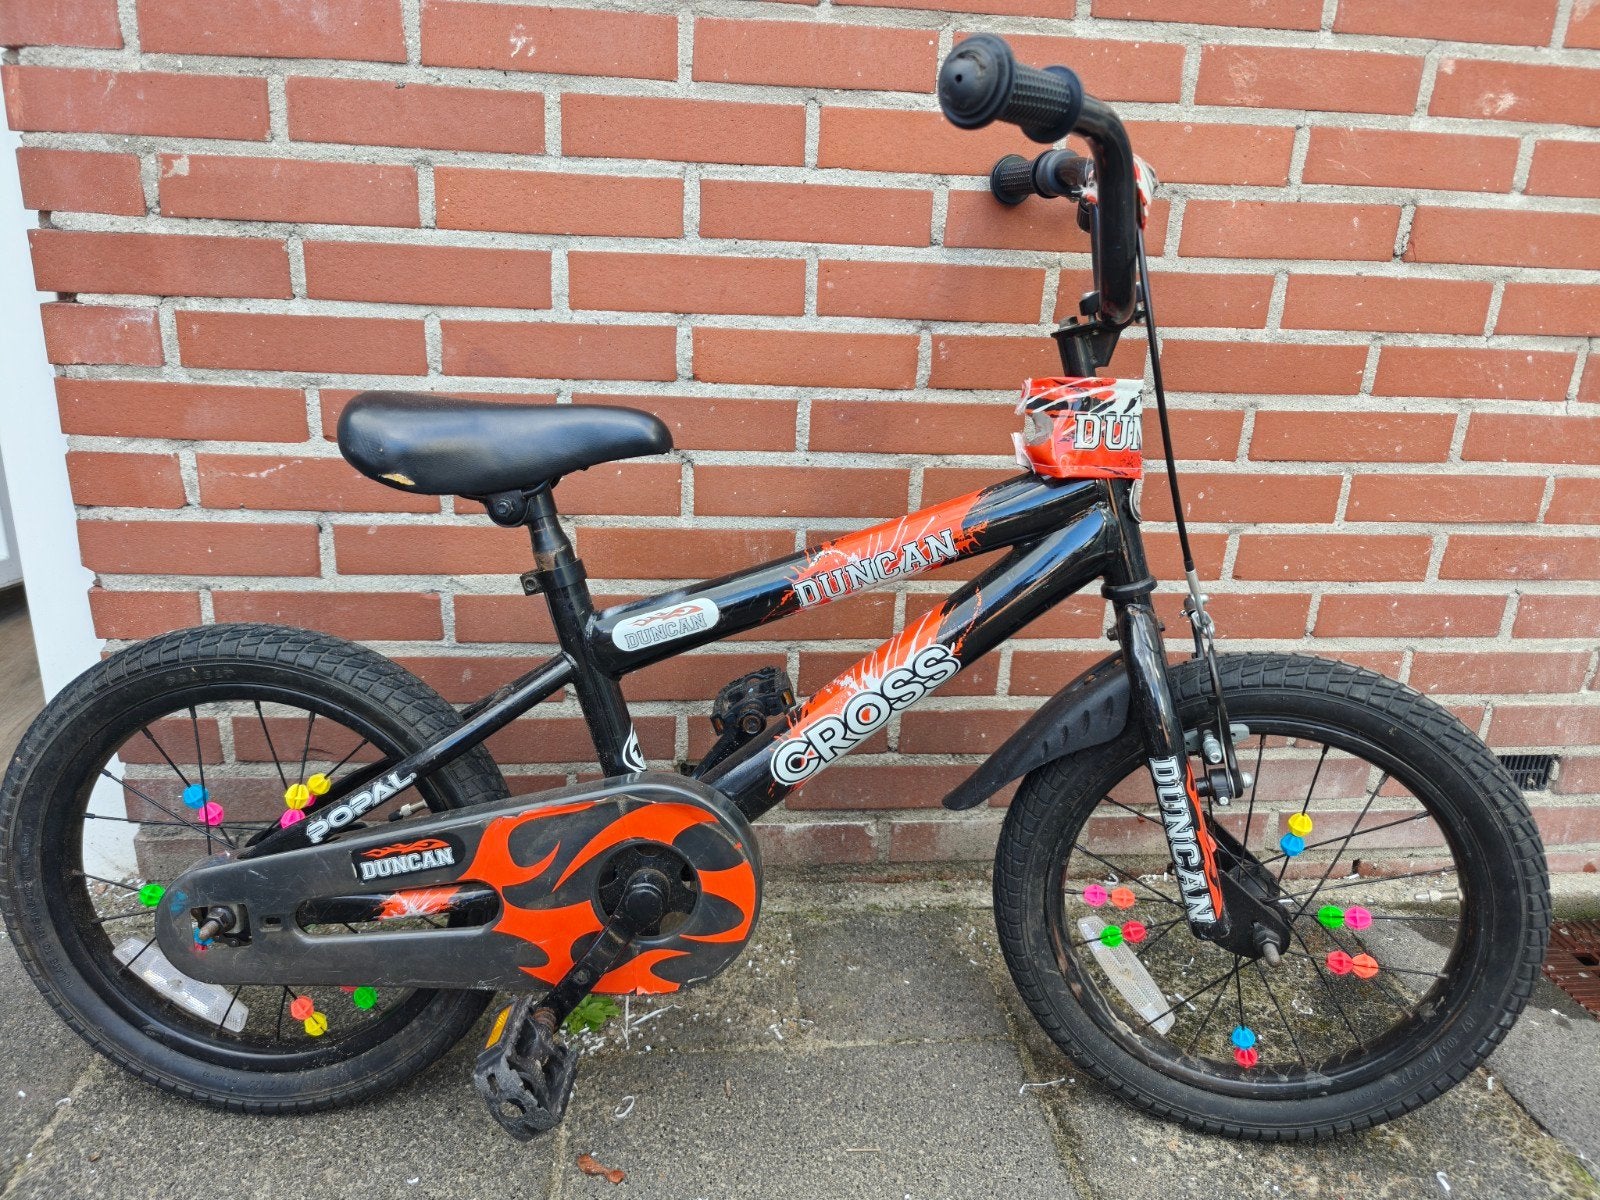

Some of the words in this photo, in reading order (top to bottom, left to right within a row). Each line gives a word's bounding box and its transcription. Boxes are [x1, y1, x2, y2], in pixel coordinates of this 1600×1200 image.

[792, 528, 959, 608] DUNCAN
[624, 612, 708, 648] DUNCAN
[769, 643, 962, 786] CROSS
[305, 770, 416, 844] POPAL
[1149, 755, 1217, 923] DUNCAN
[360, 846, 455, 881] DUNCAN
